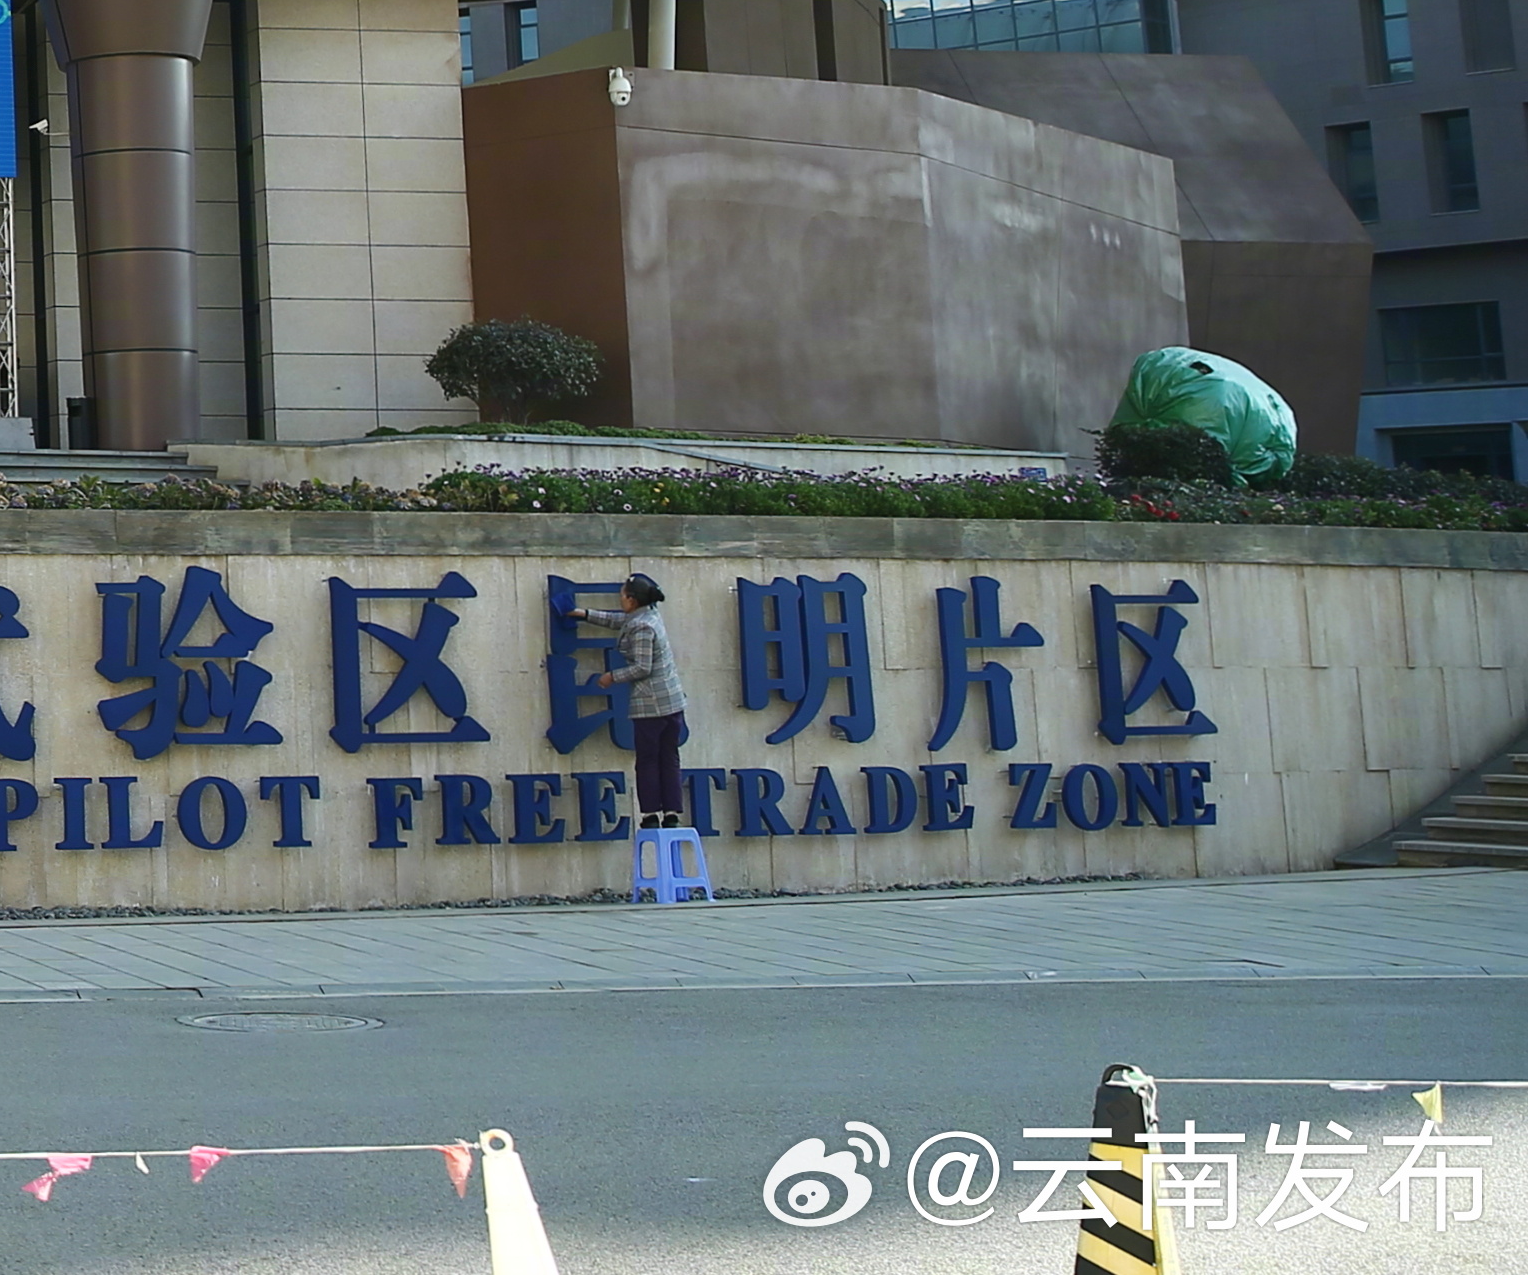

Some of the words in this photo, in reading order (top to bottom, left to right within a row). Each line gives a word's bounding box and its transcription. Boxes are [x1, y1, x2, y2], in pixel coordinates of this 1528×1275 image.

[365, 771, 633, 849] FREE
[679, 764, 976, 838] TRADE
[1007, 761, 1218, 832] ZONE
